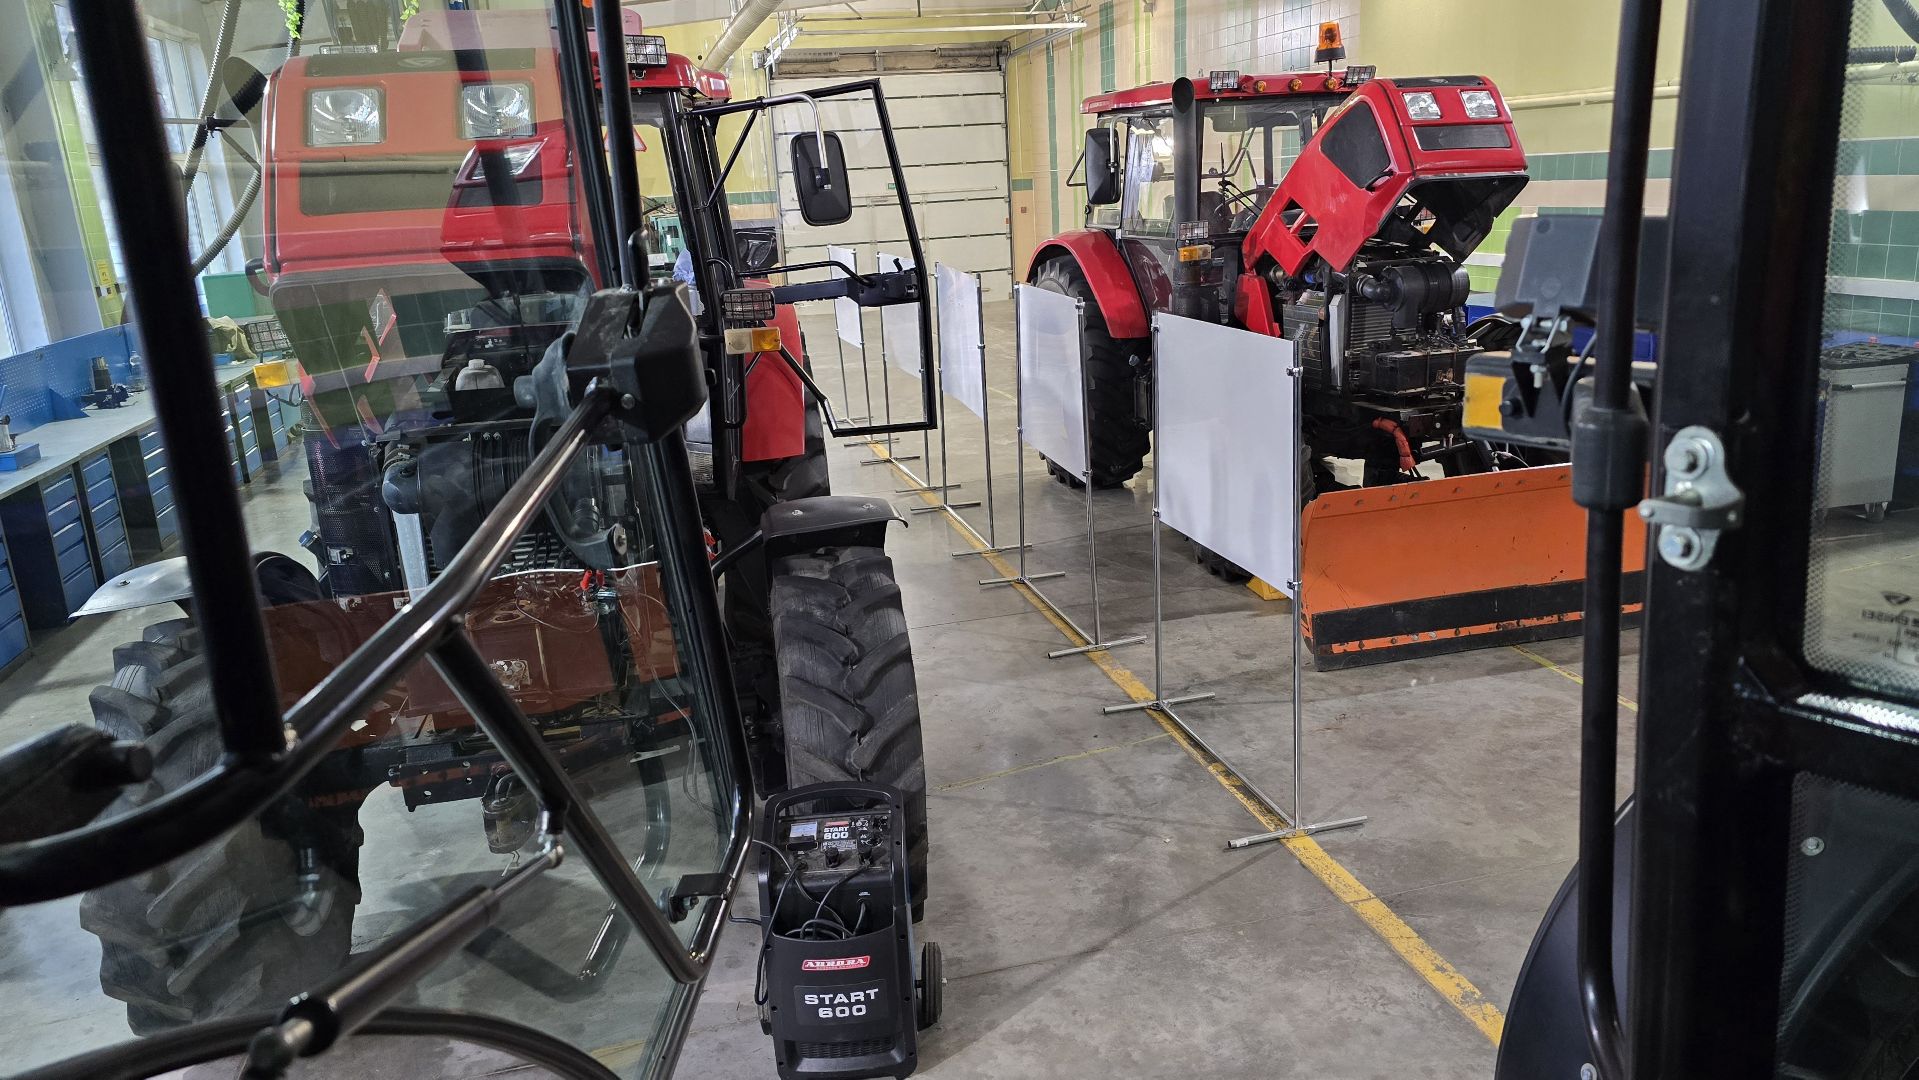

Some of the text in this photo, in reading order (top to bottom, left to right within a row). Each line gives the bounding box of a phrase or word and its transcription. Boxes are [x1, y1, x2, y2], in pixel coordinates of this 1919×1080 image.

[823, 831, 849, 840] 600
[804, 958, 866, 968] AURORA
[804, 988, 879, 1005] START
[818, 1004, 867, 1018] 600
